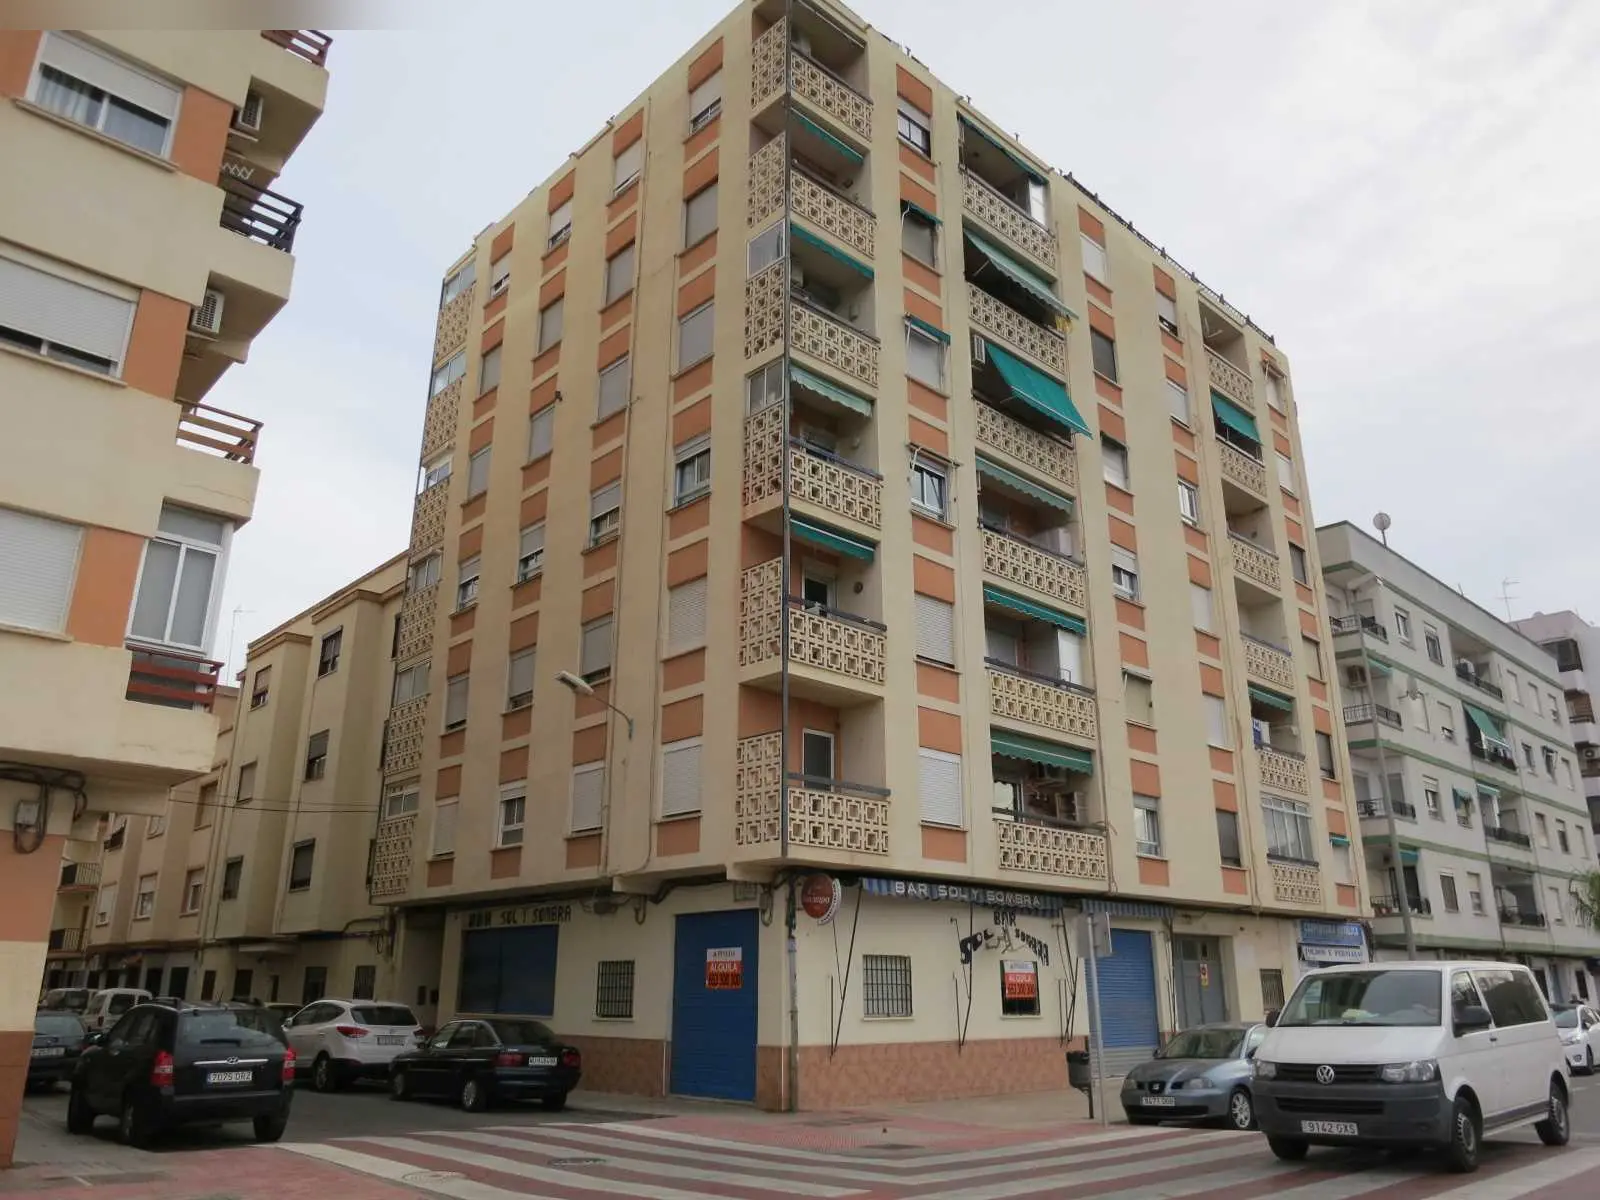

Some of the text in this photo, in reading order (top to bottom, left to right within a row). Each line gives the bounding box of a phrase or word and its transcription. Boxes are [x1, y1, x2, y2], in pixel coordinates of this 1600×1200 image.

[895, 882, 1040, 906] BAR SOL Y SOMBRA
[993, 910, 1017, 927] BAR
[1307, 1121, 1333, 1133] 9142
